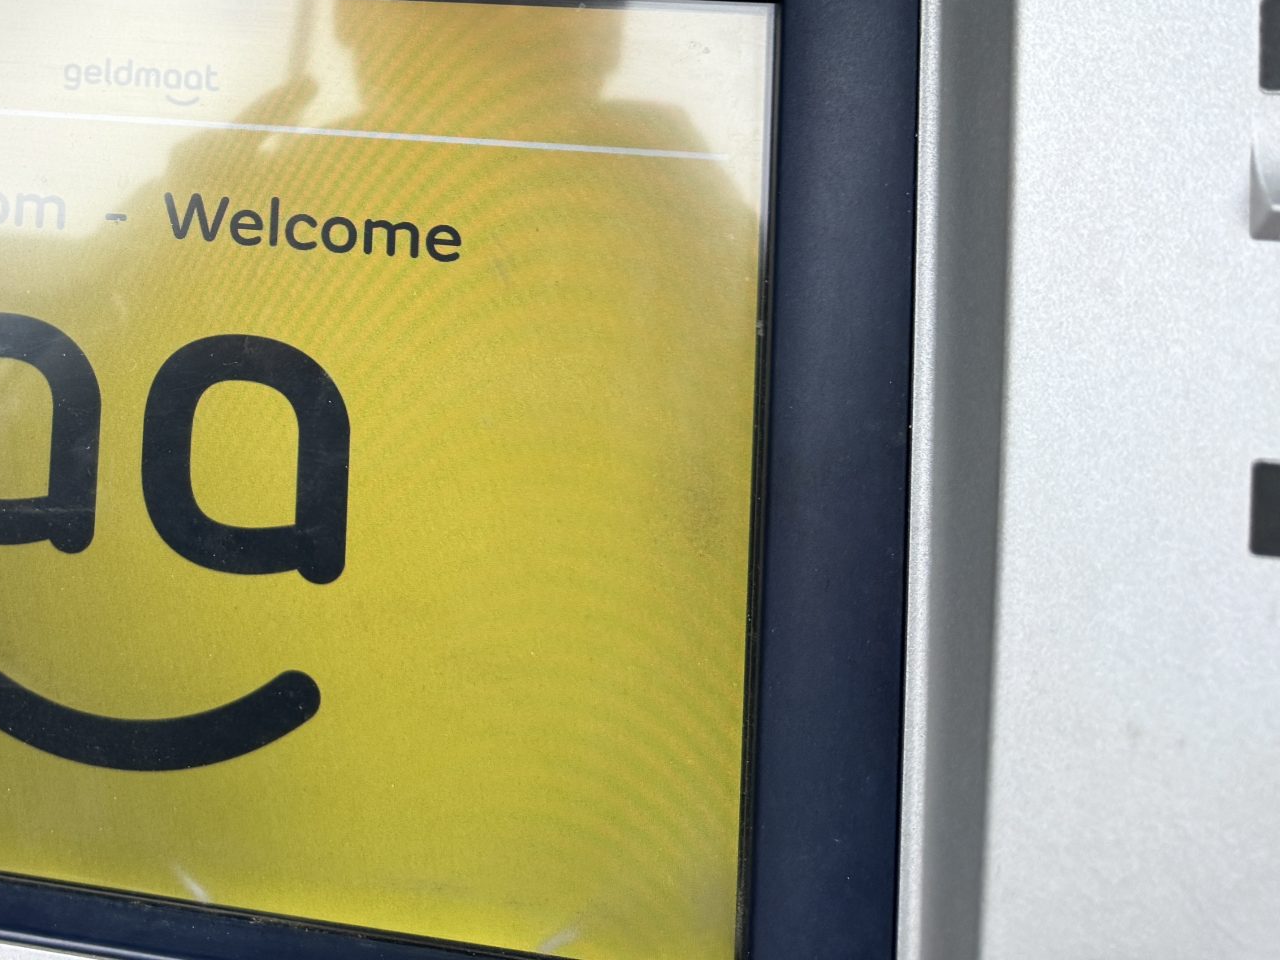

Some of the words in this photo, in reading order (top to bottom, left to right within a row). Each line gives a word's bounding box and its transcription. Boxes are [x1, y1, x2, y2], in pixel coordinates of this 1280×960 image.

[63, 57, 220, 92] geldmaat
[105, 211, 128, 223] -
[164, 192, 463, 263] Welcome
